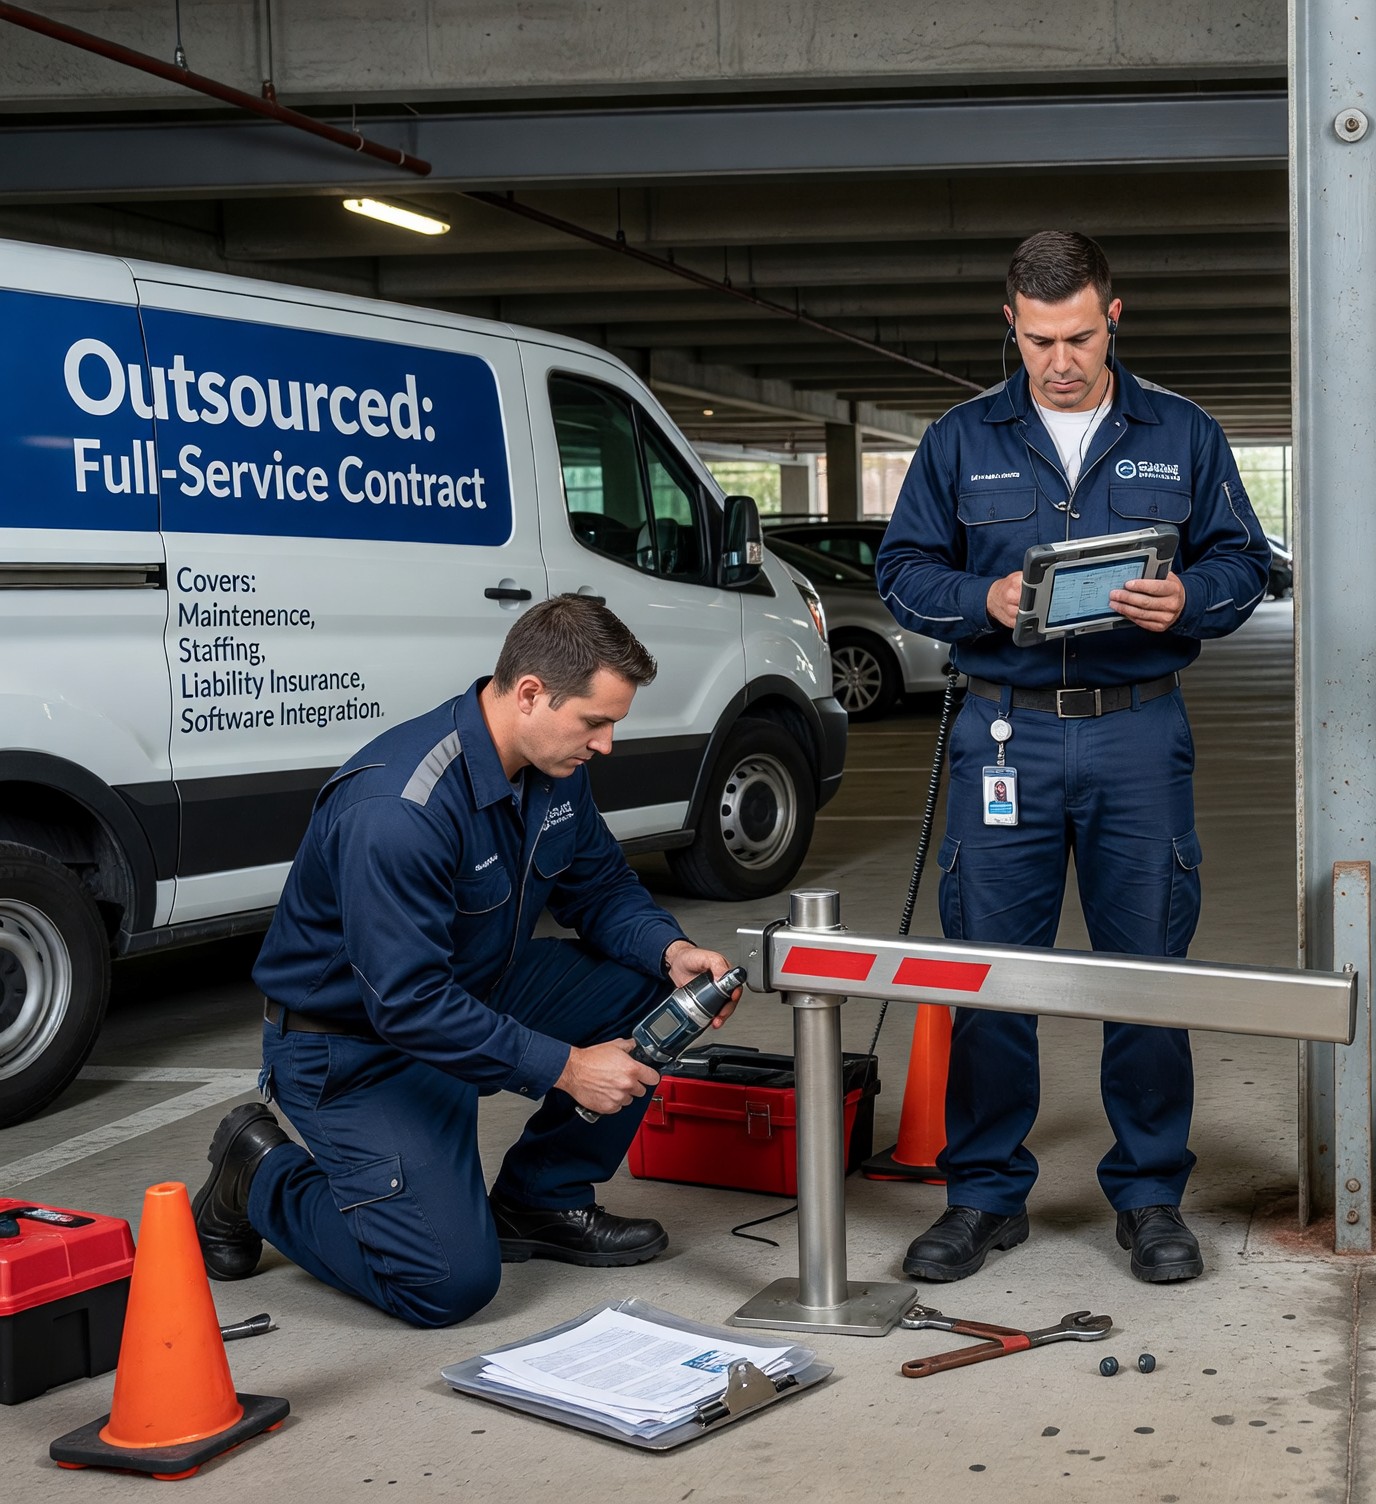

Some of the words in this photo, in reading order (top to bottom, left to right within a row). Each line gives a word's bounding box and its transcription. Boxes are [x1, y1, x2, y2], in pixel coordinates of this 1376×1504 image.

[63, 338, 436, 442] Outsourced:
[73, 438, 329, 502] Full-Service
[338, 455, 487, 509] Contract
[176, 566, 256, 593] Covers:
[178, 602, 315, 630] Maintenence,
[179, 636, 266, 666] Staffing,
[181, 670, 264, 700] Liability
[270, 669, 366, 698] Insurance,
[180, 705, 275, 734] Software
[280, 697, 385, 728] Integration.
